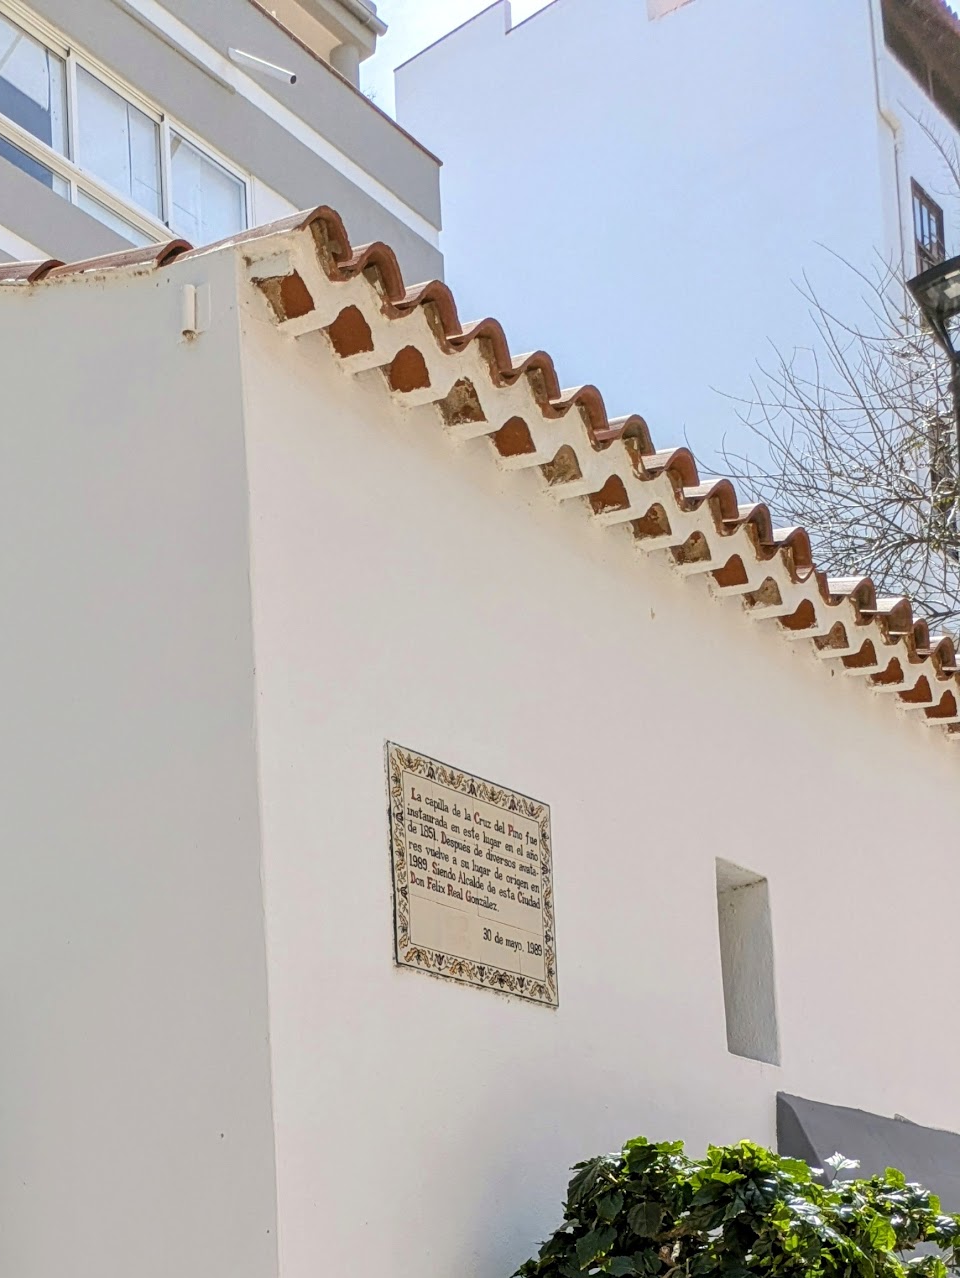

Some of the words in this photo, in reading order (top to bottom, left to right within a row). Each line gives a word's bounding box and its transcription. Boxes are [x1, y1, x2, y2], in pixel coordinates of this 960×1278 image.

[407, 803, 448, 829] instaurada
[451, 824, 461, 834] en
[463, 827, 480, 840] este
[483, 831, 501, 849] lugar
[505, 843, 514, 853] en
[517, 844, 524, 857] el
[411, 787, 422, 802] La
[425, 797, 449, 813] capilla
[452, 804, 461, 817] de
[464, 808, 472, 821] la
[474, 811, 491, 829] Cruz
[494, 820, 505, 834] del
[508, 824, 522, 840] Pino
[526, 831, 538, 846] fue
[407, 820, 417, 834] de
[474, 844, 483, 857] de
[486, 848, 516, 869] diversos
[409, 841, 422, 853] res
[425, 847, 449, 862] vuelve
[452, 857, 458, 865] a
[460, 860, 470, 870] su
[472, 859, 491, 877] lugar
[494, 866, 503, 881] de
[506, 874, 529, 890] origen
[531, 884, 540, 894] en
[409, 853, 430, 873] 1989.
[432, 861, 456, 881] Siendo
[458, 870, 484, 891] Alcalde
[487, 880, 496, 894] de
[499, 887, 515, 901] esta
[517, 891, 541, 910] Ciudad
[410, 870, 425, 887] Don
[447, 884, 463, 901] Real
[483, 927, 492, 942] 30
[494, 931, 504, 945] de
[526, 941, 543, 957] 1989
